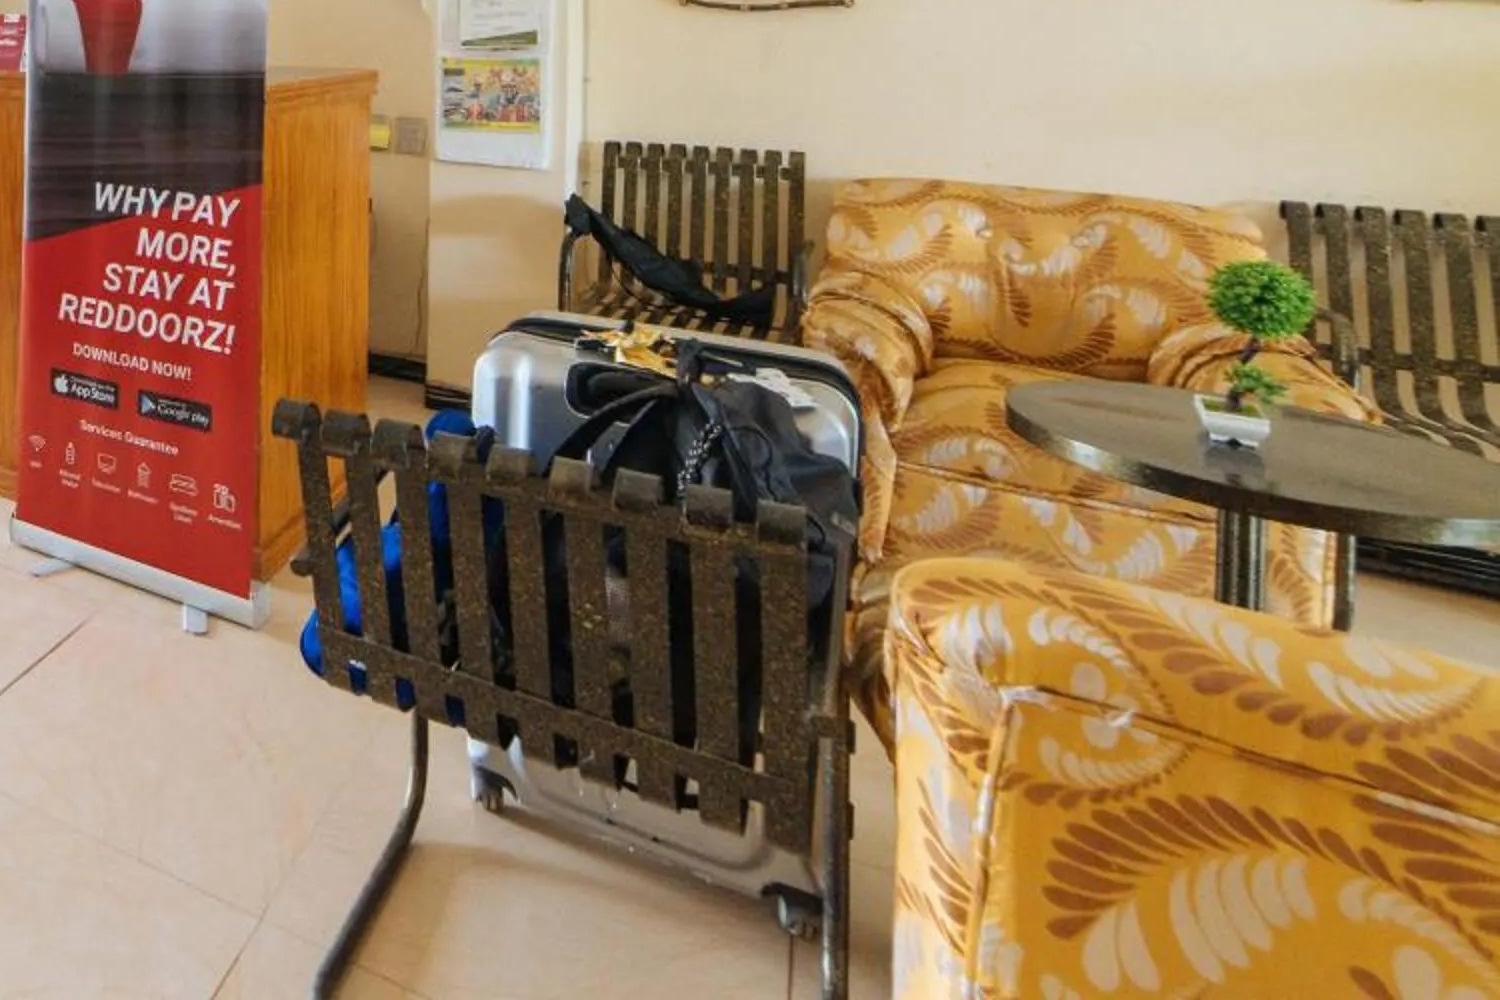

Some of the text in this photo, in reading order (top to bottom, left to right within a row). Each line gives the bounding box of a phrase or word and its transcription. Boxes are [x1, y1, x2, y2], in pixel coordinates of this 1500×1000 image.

[94, 182, 241, 228] WHY PAY
[136, 227, 237, 277] MORE,
[103, 263, 236, 311] STAY AT
[58, 293, 236, 355] REDDOORZ!
[72, 342, 192, 381] DOWNLOAD NOW!
[157, 403, 190, 420] Google
[79, 419, 180, 456] Services Guarantee
